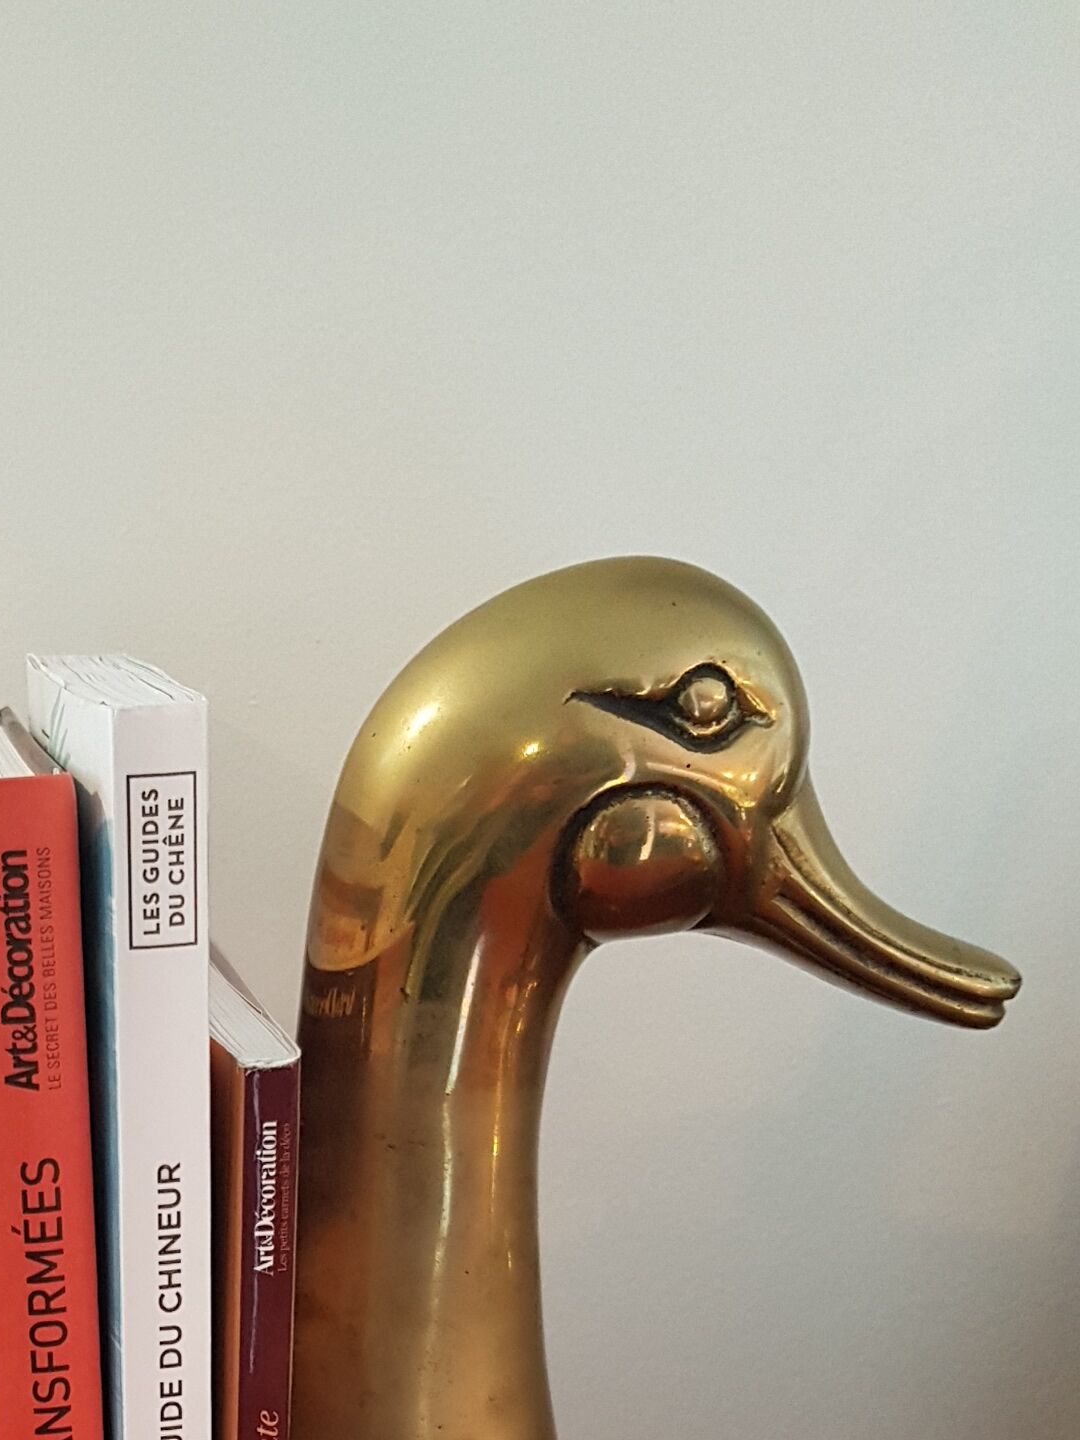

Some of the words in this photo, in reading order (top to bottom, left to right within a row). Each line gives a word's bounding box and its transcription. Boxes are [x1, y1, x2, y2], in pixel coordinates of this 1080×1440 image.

[141, 787, 160, 885] GUIDES
[162, 796, 186, 887] CHÊNE
[36, 846, 54, 922] MAISONS
[143, 890, 162, 936] LES
[168, 892, 186, 928] DU
[40, 925, 56, 978] BELLES
[43, 981, 57, 1010] DES
[44, 1015, 61, 1069] SECRET
[48, 1074, 62, 1091] LE
[280, 1161, 289, 1178] de
[253, 1120, 278, 1277] Art&Décoration
[156, 1161, 183, 1314] CHINEUR
[277, 1253, 288, 1273] Les
[159, 1324, 183, 1371] DU
